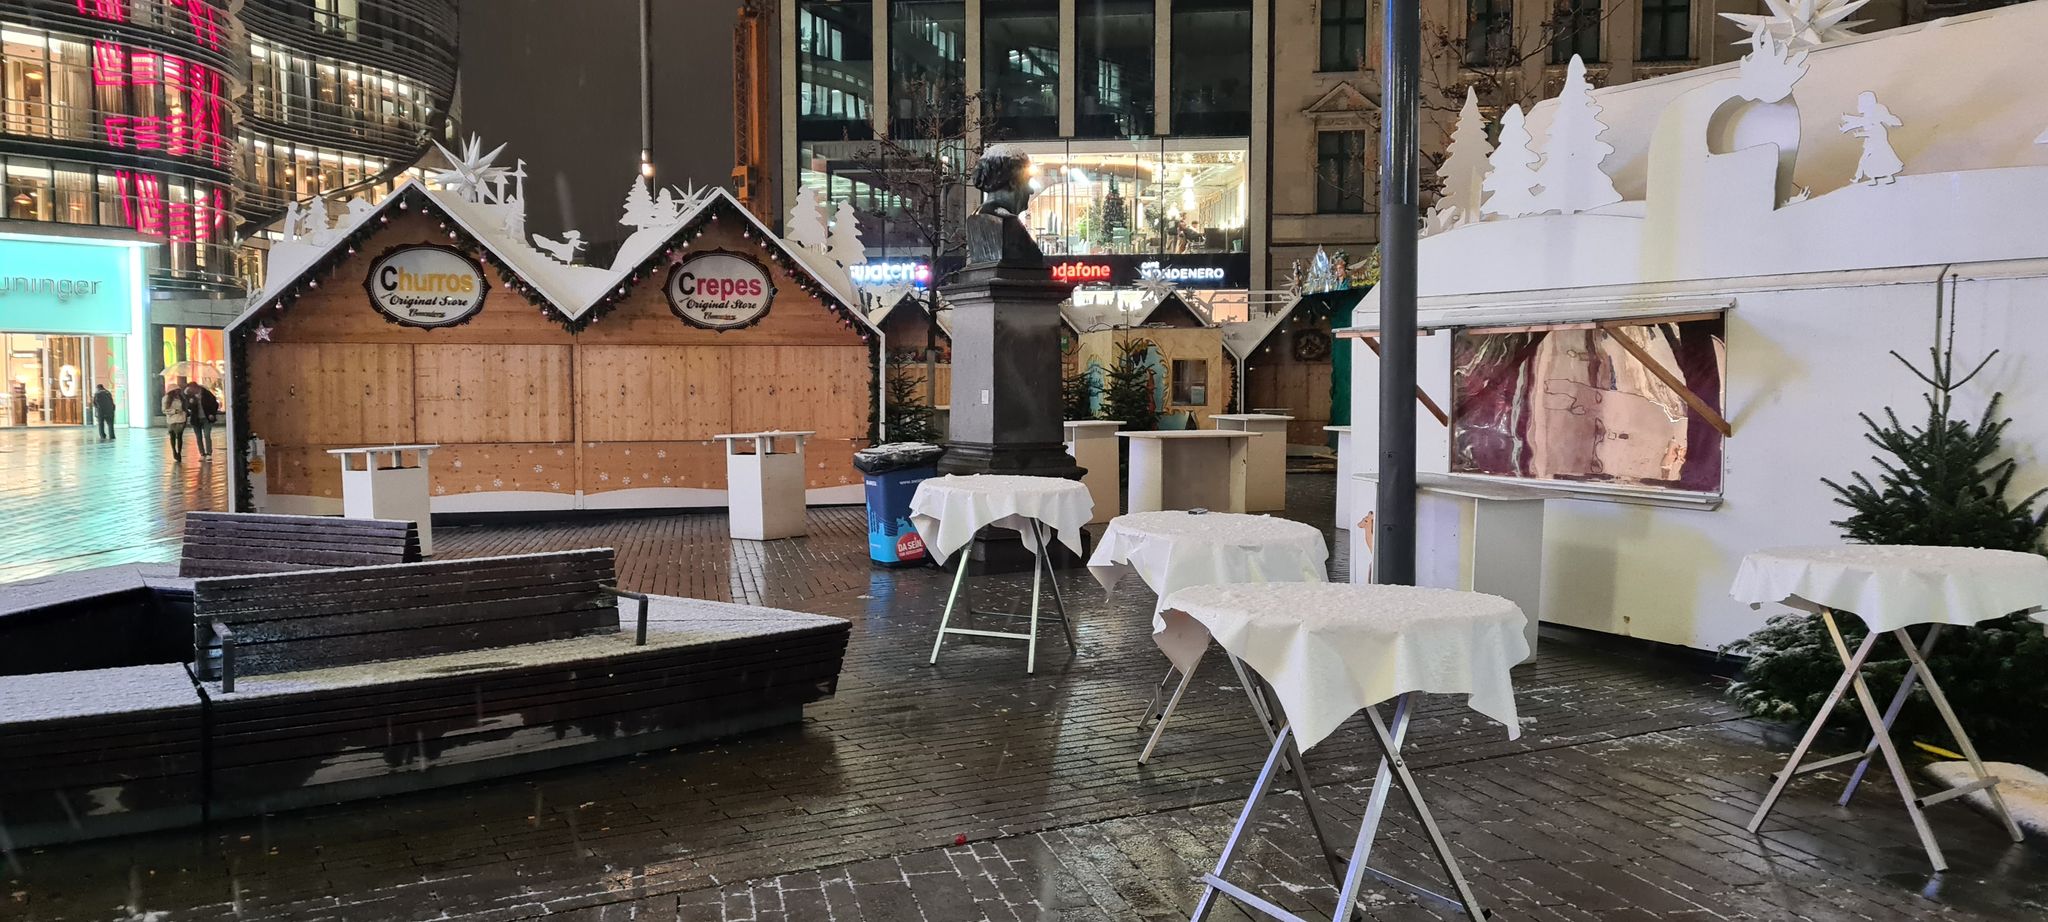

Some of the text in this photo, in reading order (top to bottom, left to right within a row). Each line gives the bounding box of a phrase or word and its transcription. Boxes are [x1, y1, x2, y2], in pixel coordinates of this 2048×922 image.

[380, 265, 473, 292] Churros
[1141, 268, 1225, 279] MONDENERO
[678, 272, 762, 301] Crepes
[389, 296, 437, 308] Original
[686, 298, 757, 311] Original Store
[897, 543, 908, 553] DA
